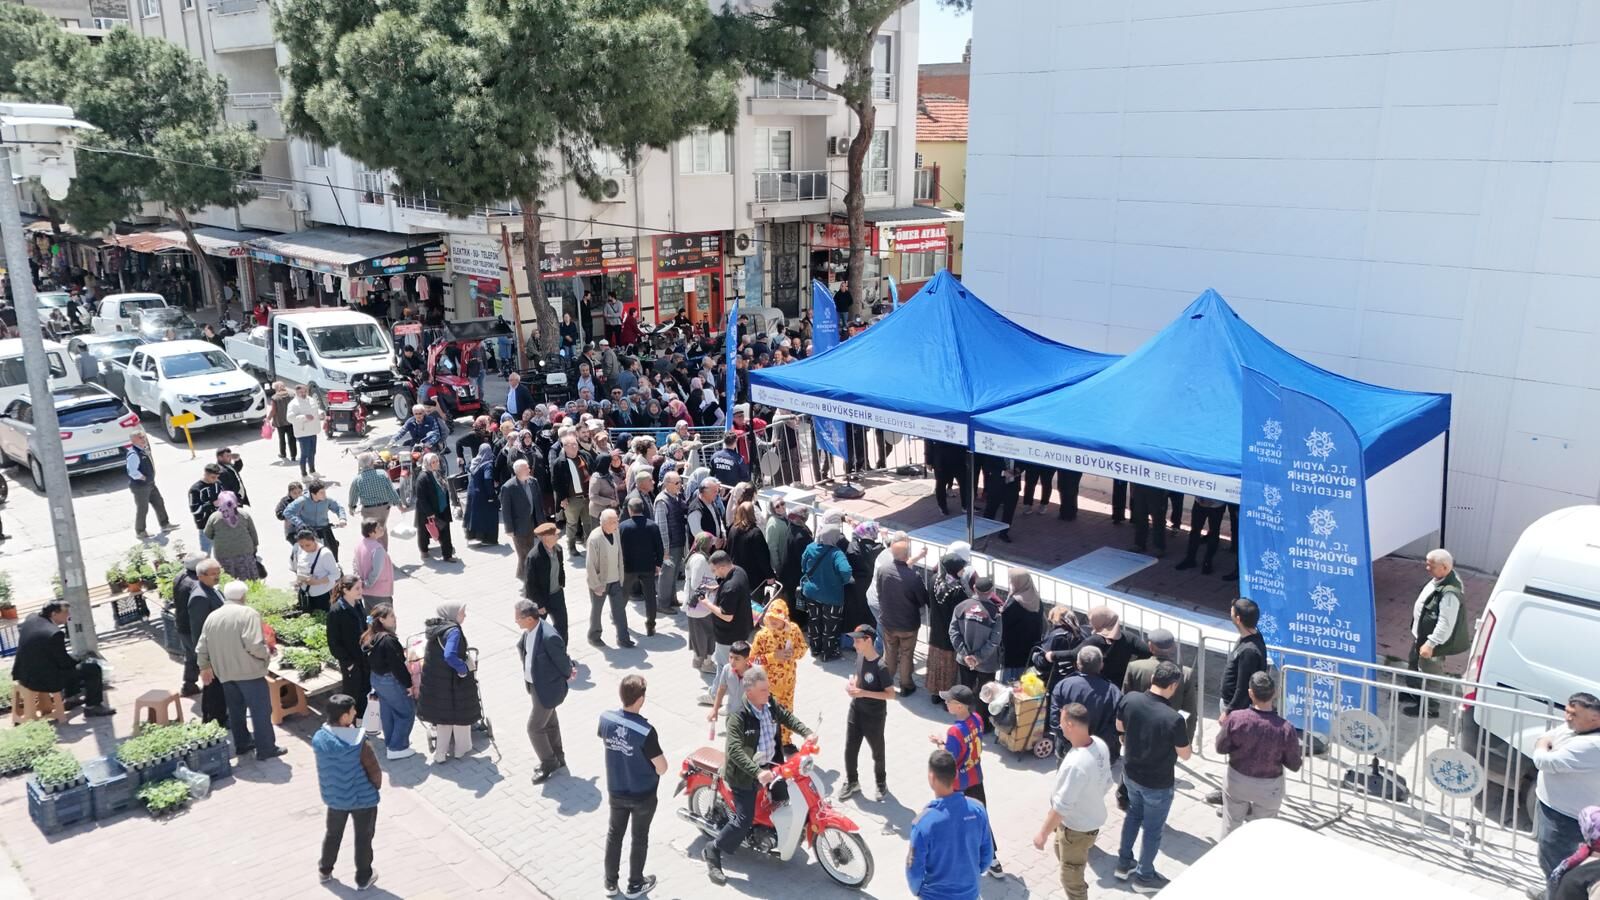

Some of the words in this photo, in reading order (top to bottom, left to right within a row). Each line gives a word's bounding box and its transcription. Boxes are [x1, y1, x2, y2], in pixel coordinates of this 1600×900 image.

[896, 228, 919, 241] ÖMER
[801, 401, 820, 410] AYDIN
[822, 402, 873, 421] BÜYÜKŞEHİR
[875, 415, 915, 429] BELEDİYESİ
[1028, 447, 1042, 457] T.C.
[1044, 451, 1072, 463] AYDIN
[1075, 455, 1150, 478] BÜYÜKŞEHİR
[1154, 471, 1216, 491] BELEDİYESİ
